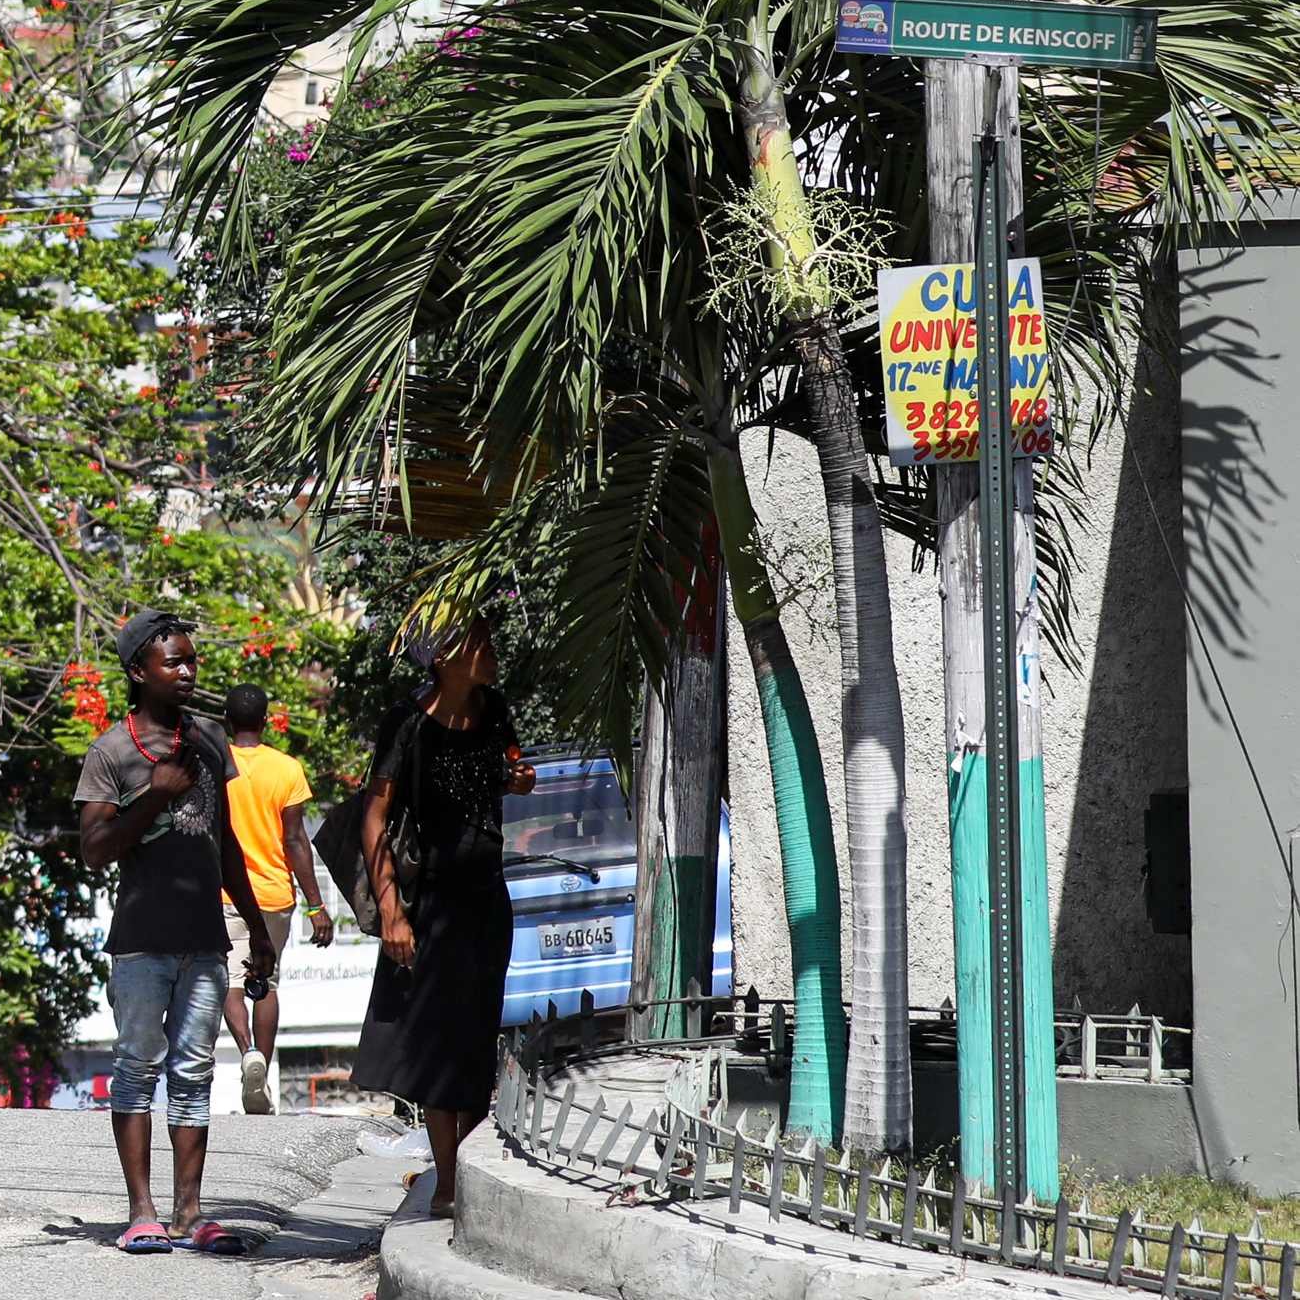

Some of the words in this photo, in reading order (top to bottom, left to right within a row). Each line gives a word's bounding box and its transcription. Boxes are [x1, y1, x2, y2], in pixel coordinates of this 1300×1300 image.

[901, 19, 971, 42] ROUTE
[976, 24, 1003, 43] DE
[1008, 26, 1116, 50] KENSCOFF
[920, 265, 1035, 313] CUA
[889, 314, 1043, 354] UNIVEITE
[942, 353, 1049, 392] MANY
[544, 926, 613, 948] BB-60645
